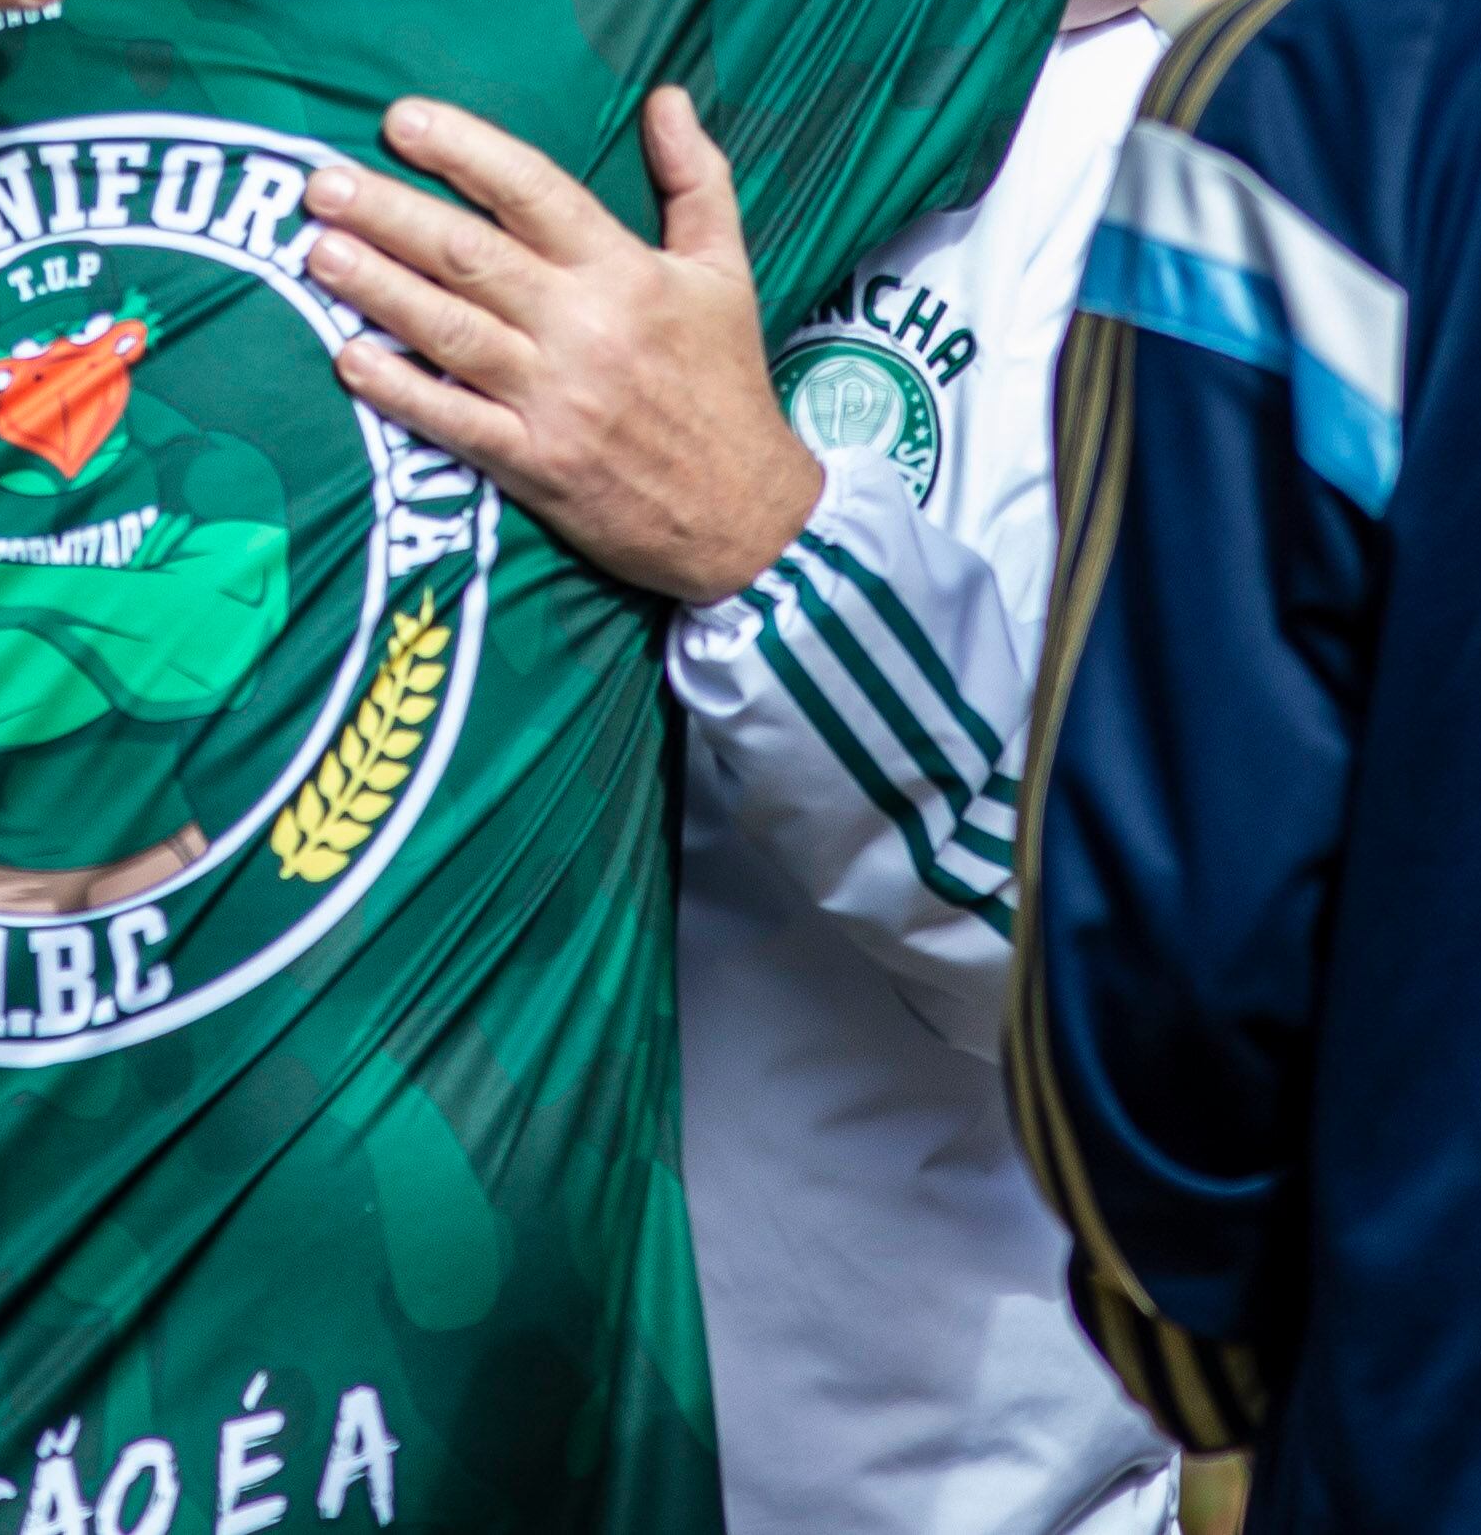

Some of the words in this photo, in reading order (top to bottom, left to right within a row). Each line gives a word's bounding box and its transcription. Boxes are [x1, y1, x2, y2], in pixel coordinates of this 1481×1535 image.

[6, 249, 102, 304] T.U.P
[219, 1370, 288, 1535] É
[318, 1385, 401, 1527] A
